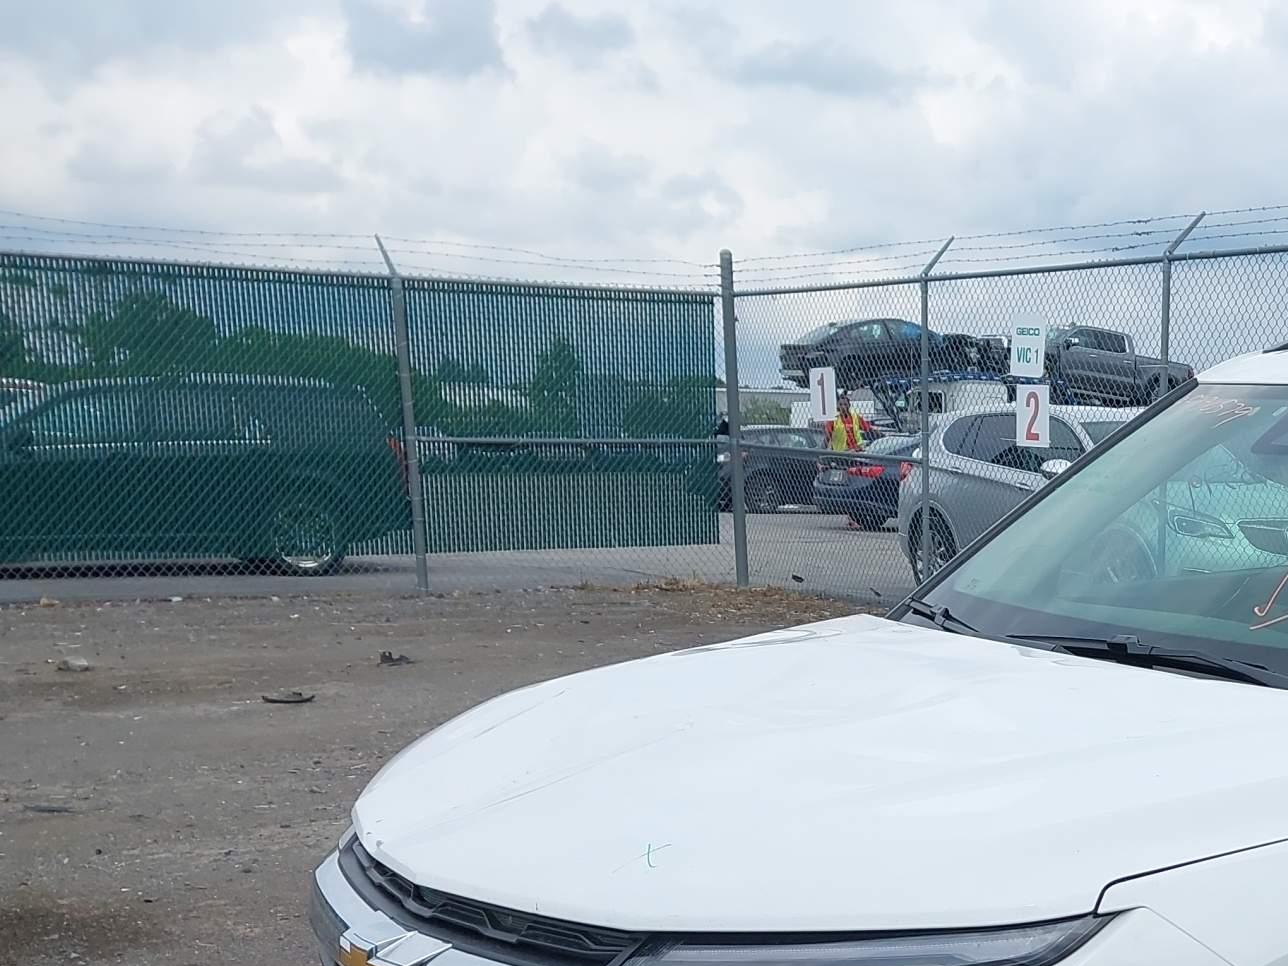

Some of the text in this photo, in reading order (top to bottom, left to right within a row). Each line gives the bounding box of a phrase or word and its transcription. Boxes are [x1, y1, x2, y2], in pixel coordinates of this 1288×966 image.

[1016, 327, 1040, 336] GEICO
[1017, 346, 1039, 364] VIC 1
[817, 372, 826, 416] 1
[1025, 391, 1040, 441] 2
